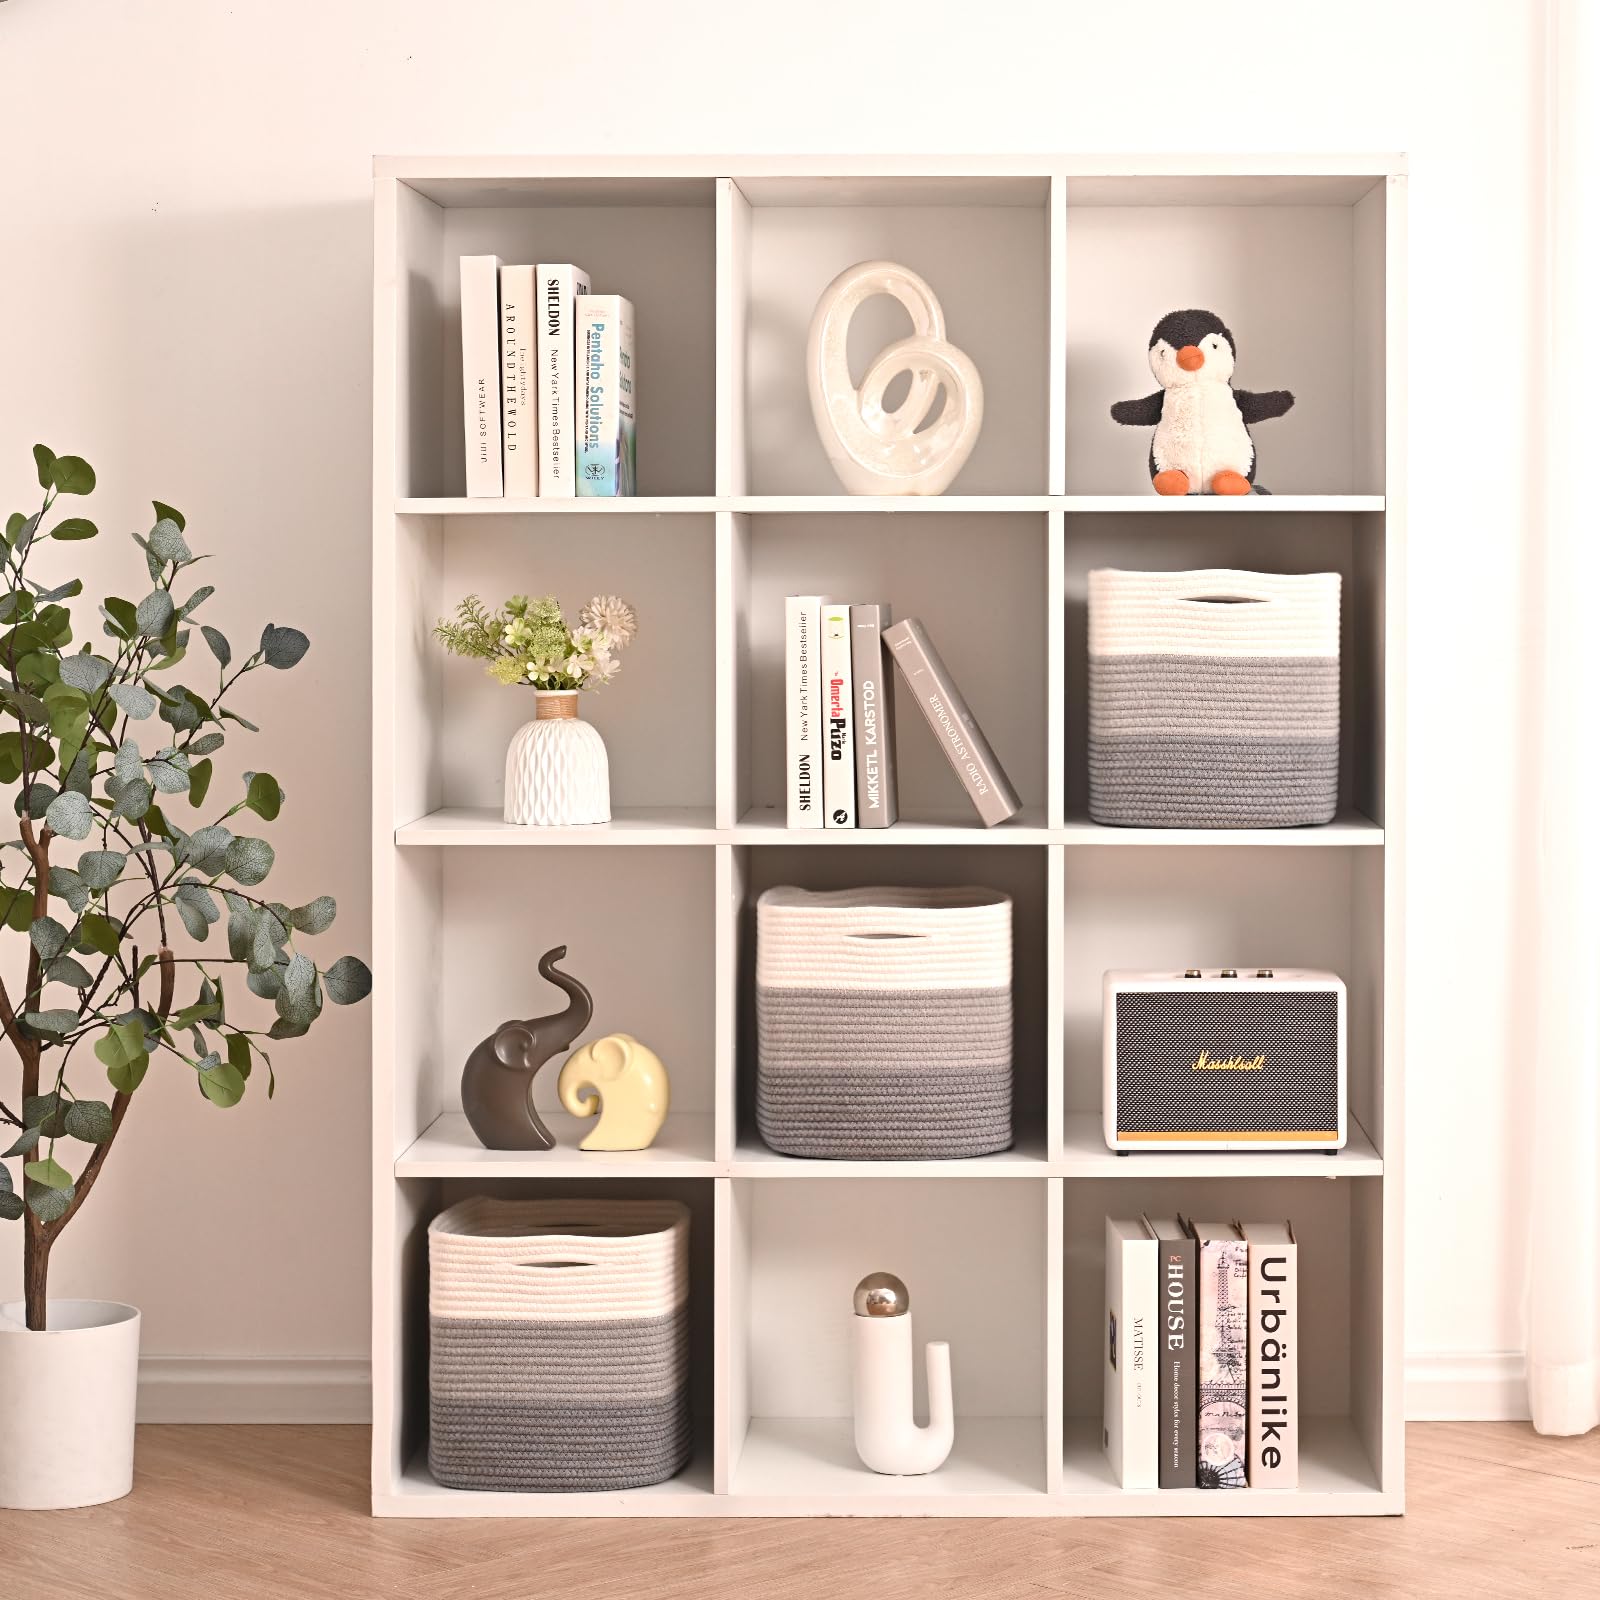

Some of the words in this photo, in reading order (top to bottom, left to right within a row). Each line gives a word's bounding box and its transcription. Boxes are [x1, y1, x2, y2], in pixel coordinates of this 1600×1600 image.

[547, 279, 561, 336] SHELDON
[550, 349, 559, 370] New
[591, 323, 605, 381] Pentaho
[551, 397, 560, 427] Times
[589, 386, 604, 449] Solutions
[799, 663, 808, 692] Times
[830, 678, 844, 718] Omerta
[800, 719, 809, 741] New
[830, 718, 847, 761] Puzo
[862, 680, 877, 745] KARSTOD
[929, 693, 971, 761] ASTRONOMER
[798, 754, 811, 812] SHELDON
[865, 749, 880, 809] MIKKETL
[966, 762, 989, 796] RADIO
[1167, 1263, 1185, 1351] HOUSE
[1133, 1317, 1144, 1371] MATISSE
[1260, 1256, 1288, 1469] Urbänlike
[1173, 1361, 1181, 1382] Home
[1173, 1419, 1181, 1429] for
